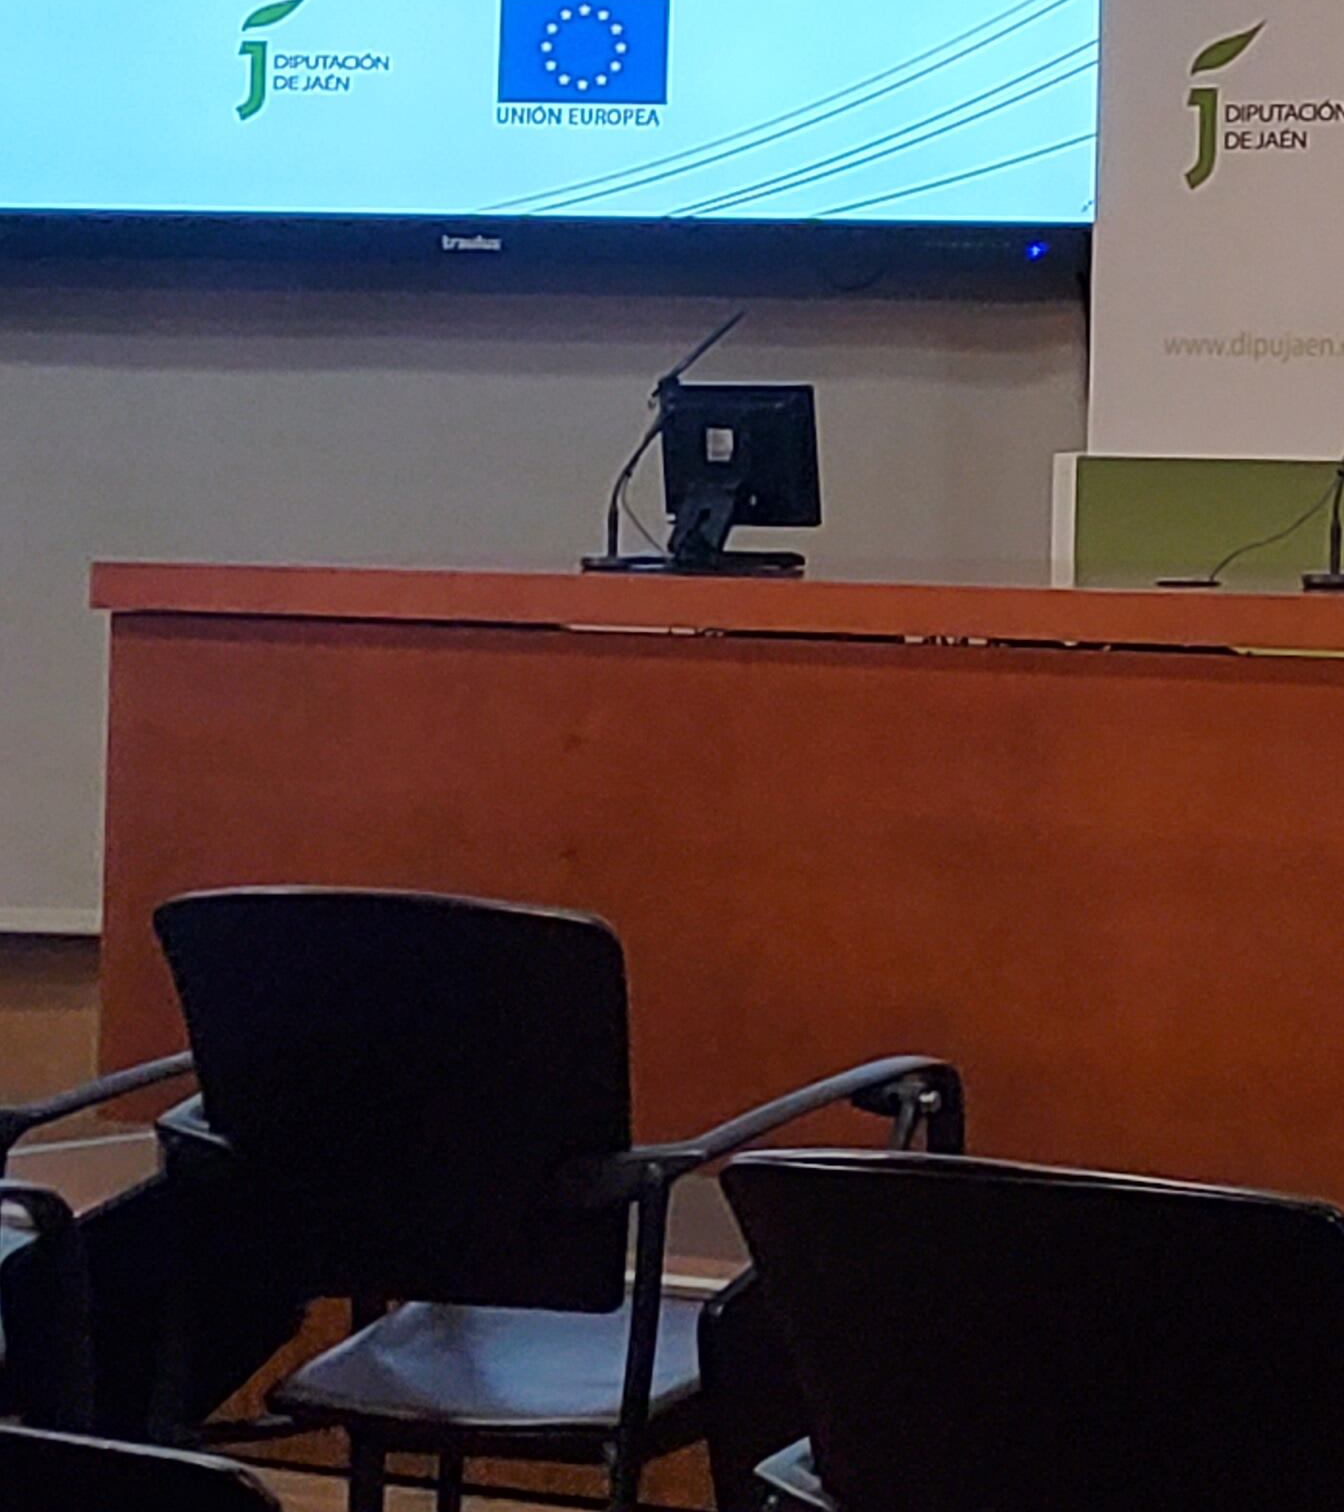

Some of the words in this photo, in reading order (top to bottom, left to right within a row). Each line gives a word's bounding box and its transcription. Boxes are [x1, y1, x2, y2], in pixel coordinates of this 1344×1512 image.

[272, 50, 391, 72] DIPUTACIÓN
[272, 75, 299, 92] DE
[302, 71, 351, 92] JAÉN
[496, 104, 563, 125] UNIÓN
[568, 107, 661, 127] EUROPEA
[1223, 130, 1253, 151] DE
[1255, 127, 1308, 151] JAÉN
